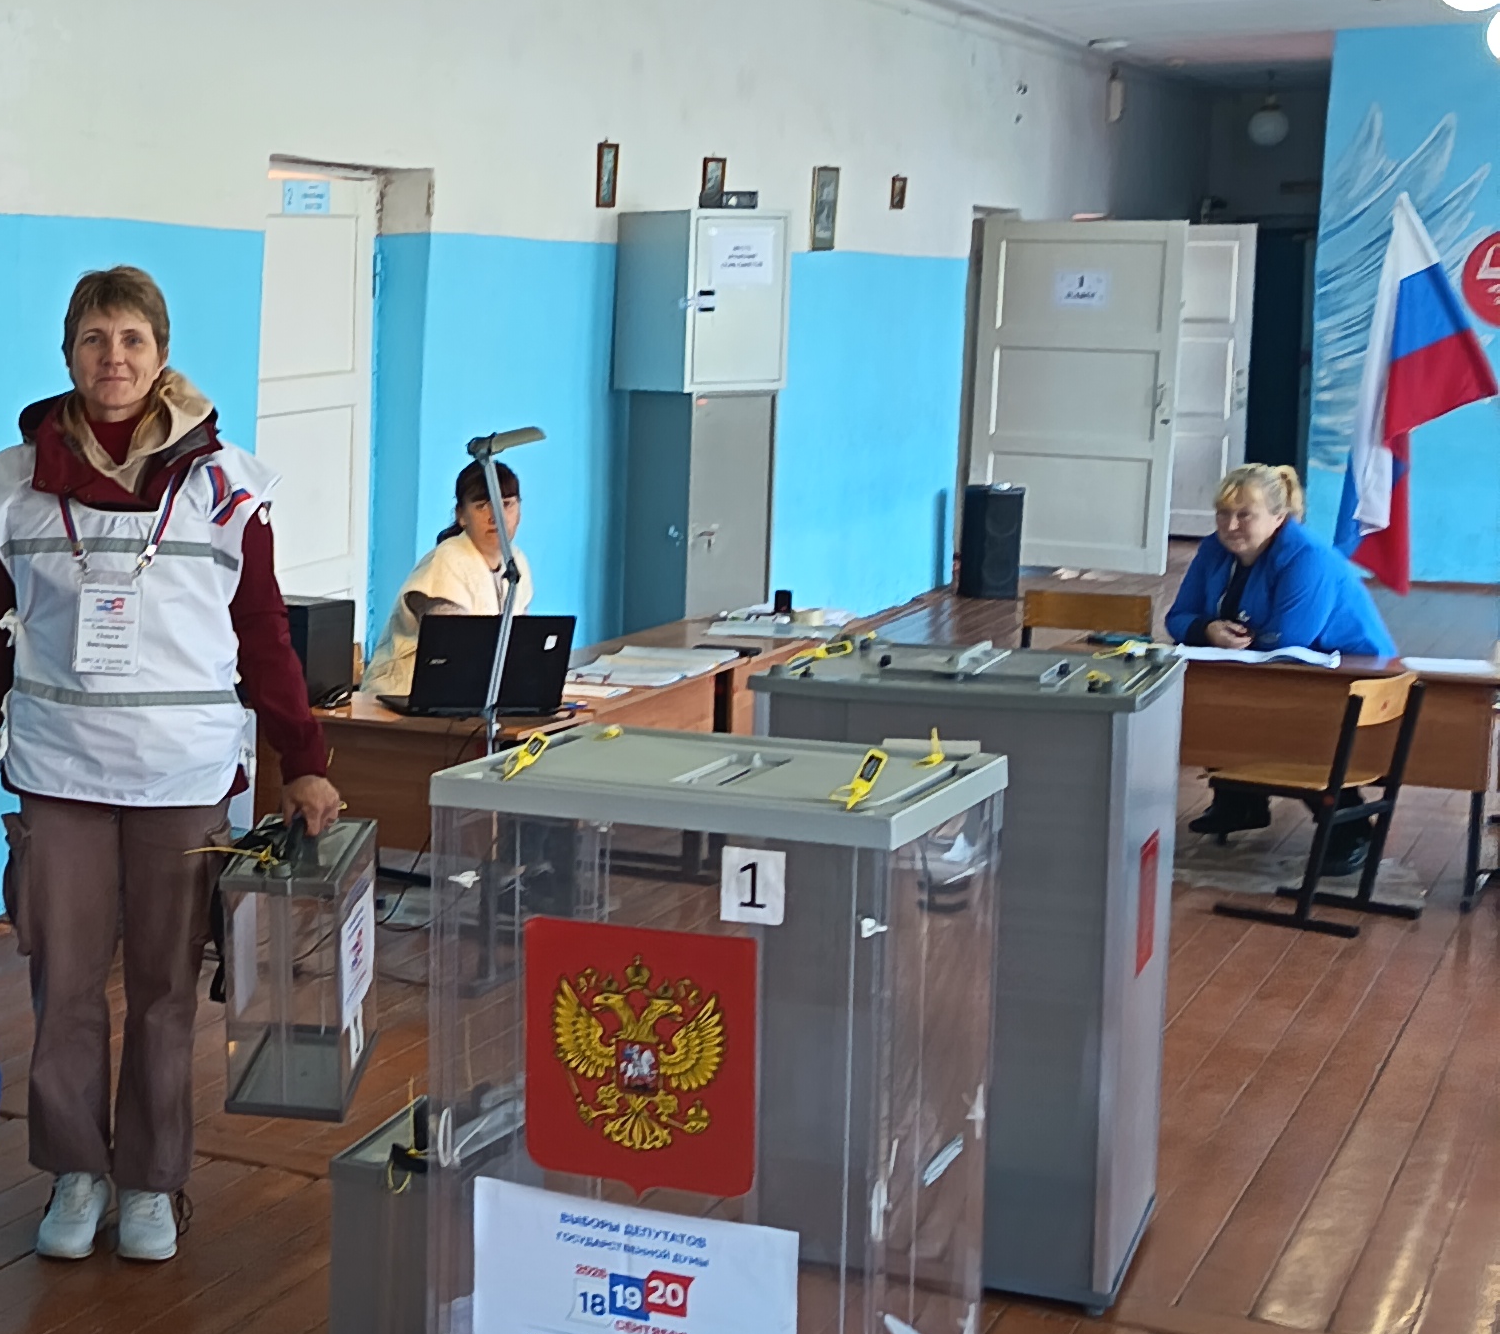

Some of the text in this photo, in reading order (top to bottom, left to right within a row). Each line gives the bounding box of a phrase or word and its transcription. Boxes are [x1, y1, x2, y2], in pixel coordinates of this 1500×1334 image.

[739, 862, 767, 909] 1
[560, 1212, 707, 1248] ВЫБОРЫ ДЕПУТАТОВ
[579, 1279, 684, 1316] 18 19 20
